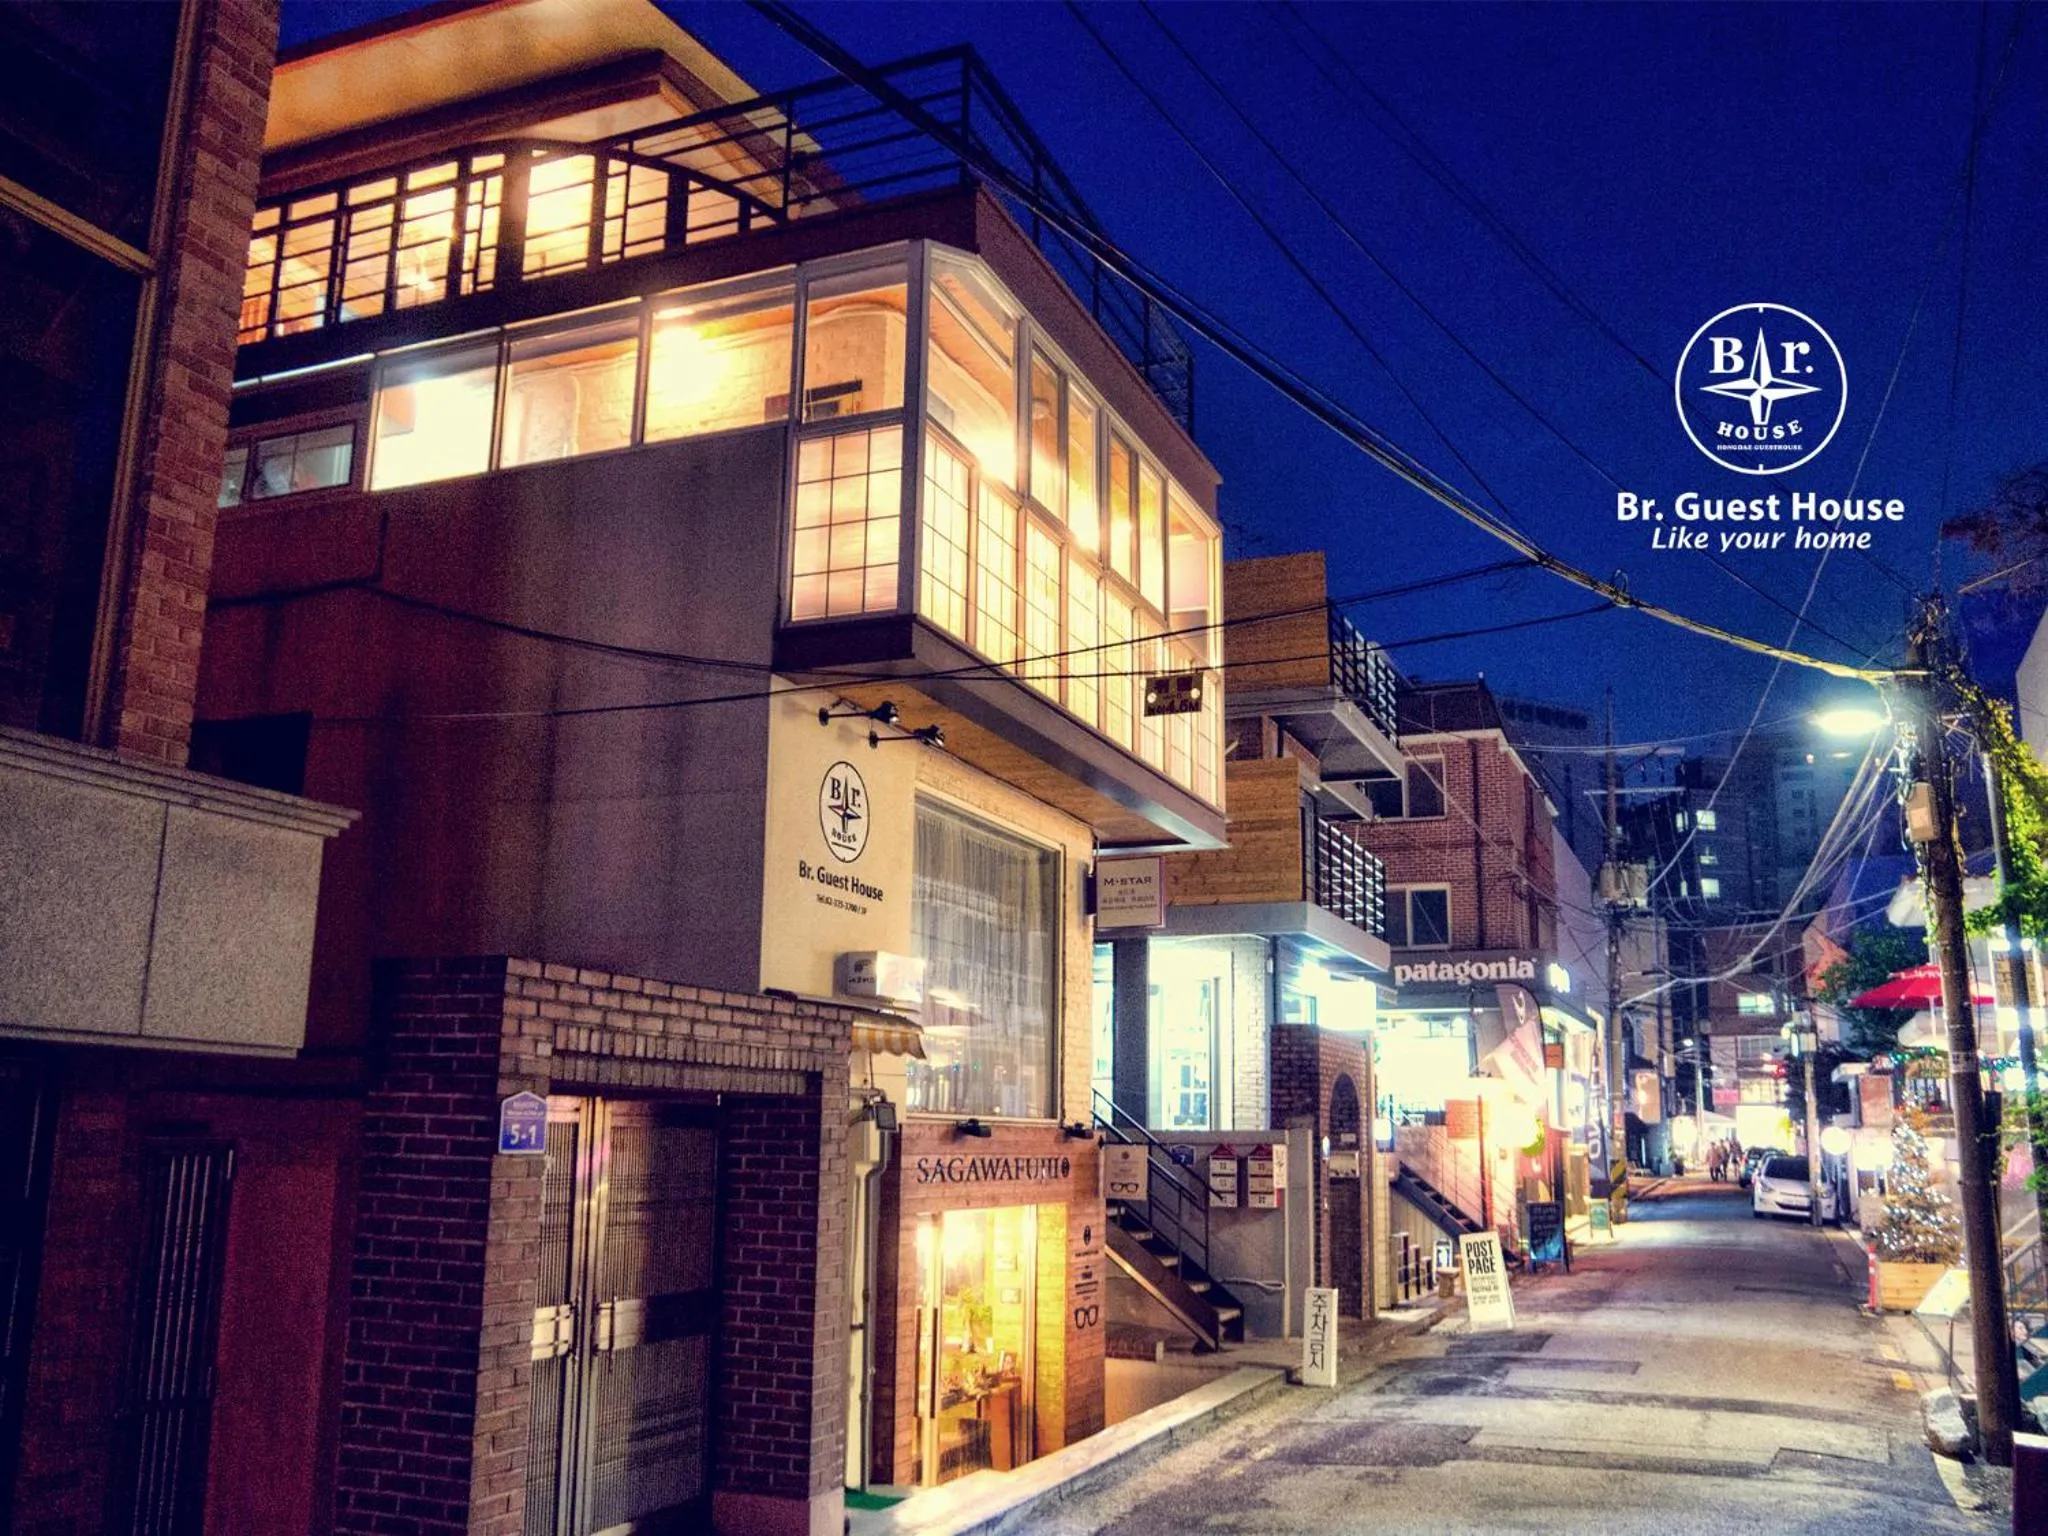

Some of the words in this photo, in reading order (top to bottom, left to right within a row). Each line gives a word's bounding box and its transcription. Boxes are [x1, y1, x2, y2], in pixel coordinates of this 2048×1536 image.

[799, 860, 815, 880] Br.
[817, 866, 849, 892] Guest
[851, 875, 884, 901] House
[1394, 956, 1535, 987] patagonia
[510, 1124, 537, 1145] 5-1
[1465, 1239, 1494, 1258] POST
[1468, 1257, 1496, 1275] PAGE
[1309, 1293, 1328, 1371] 주차금지
